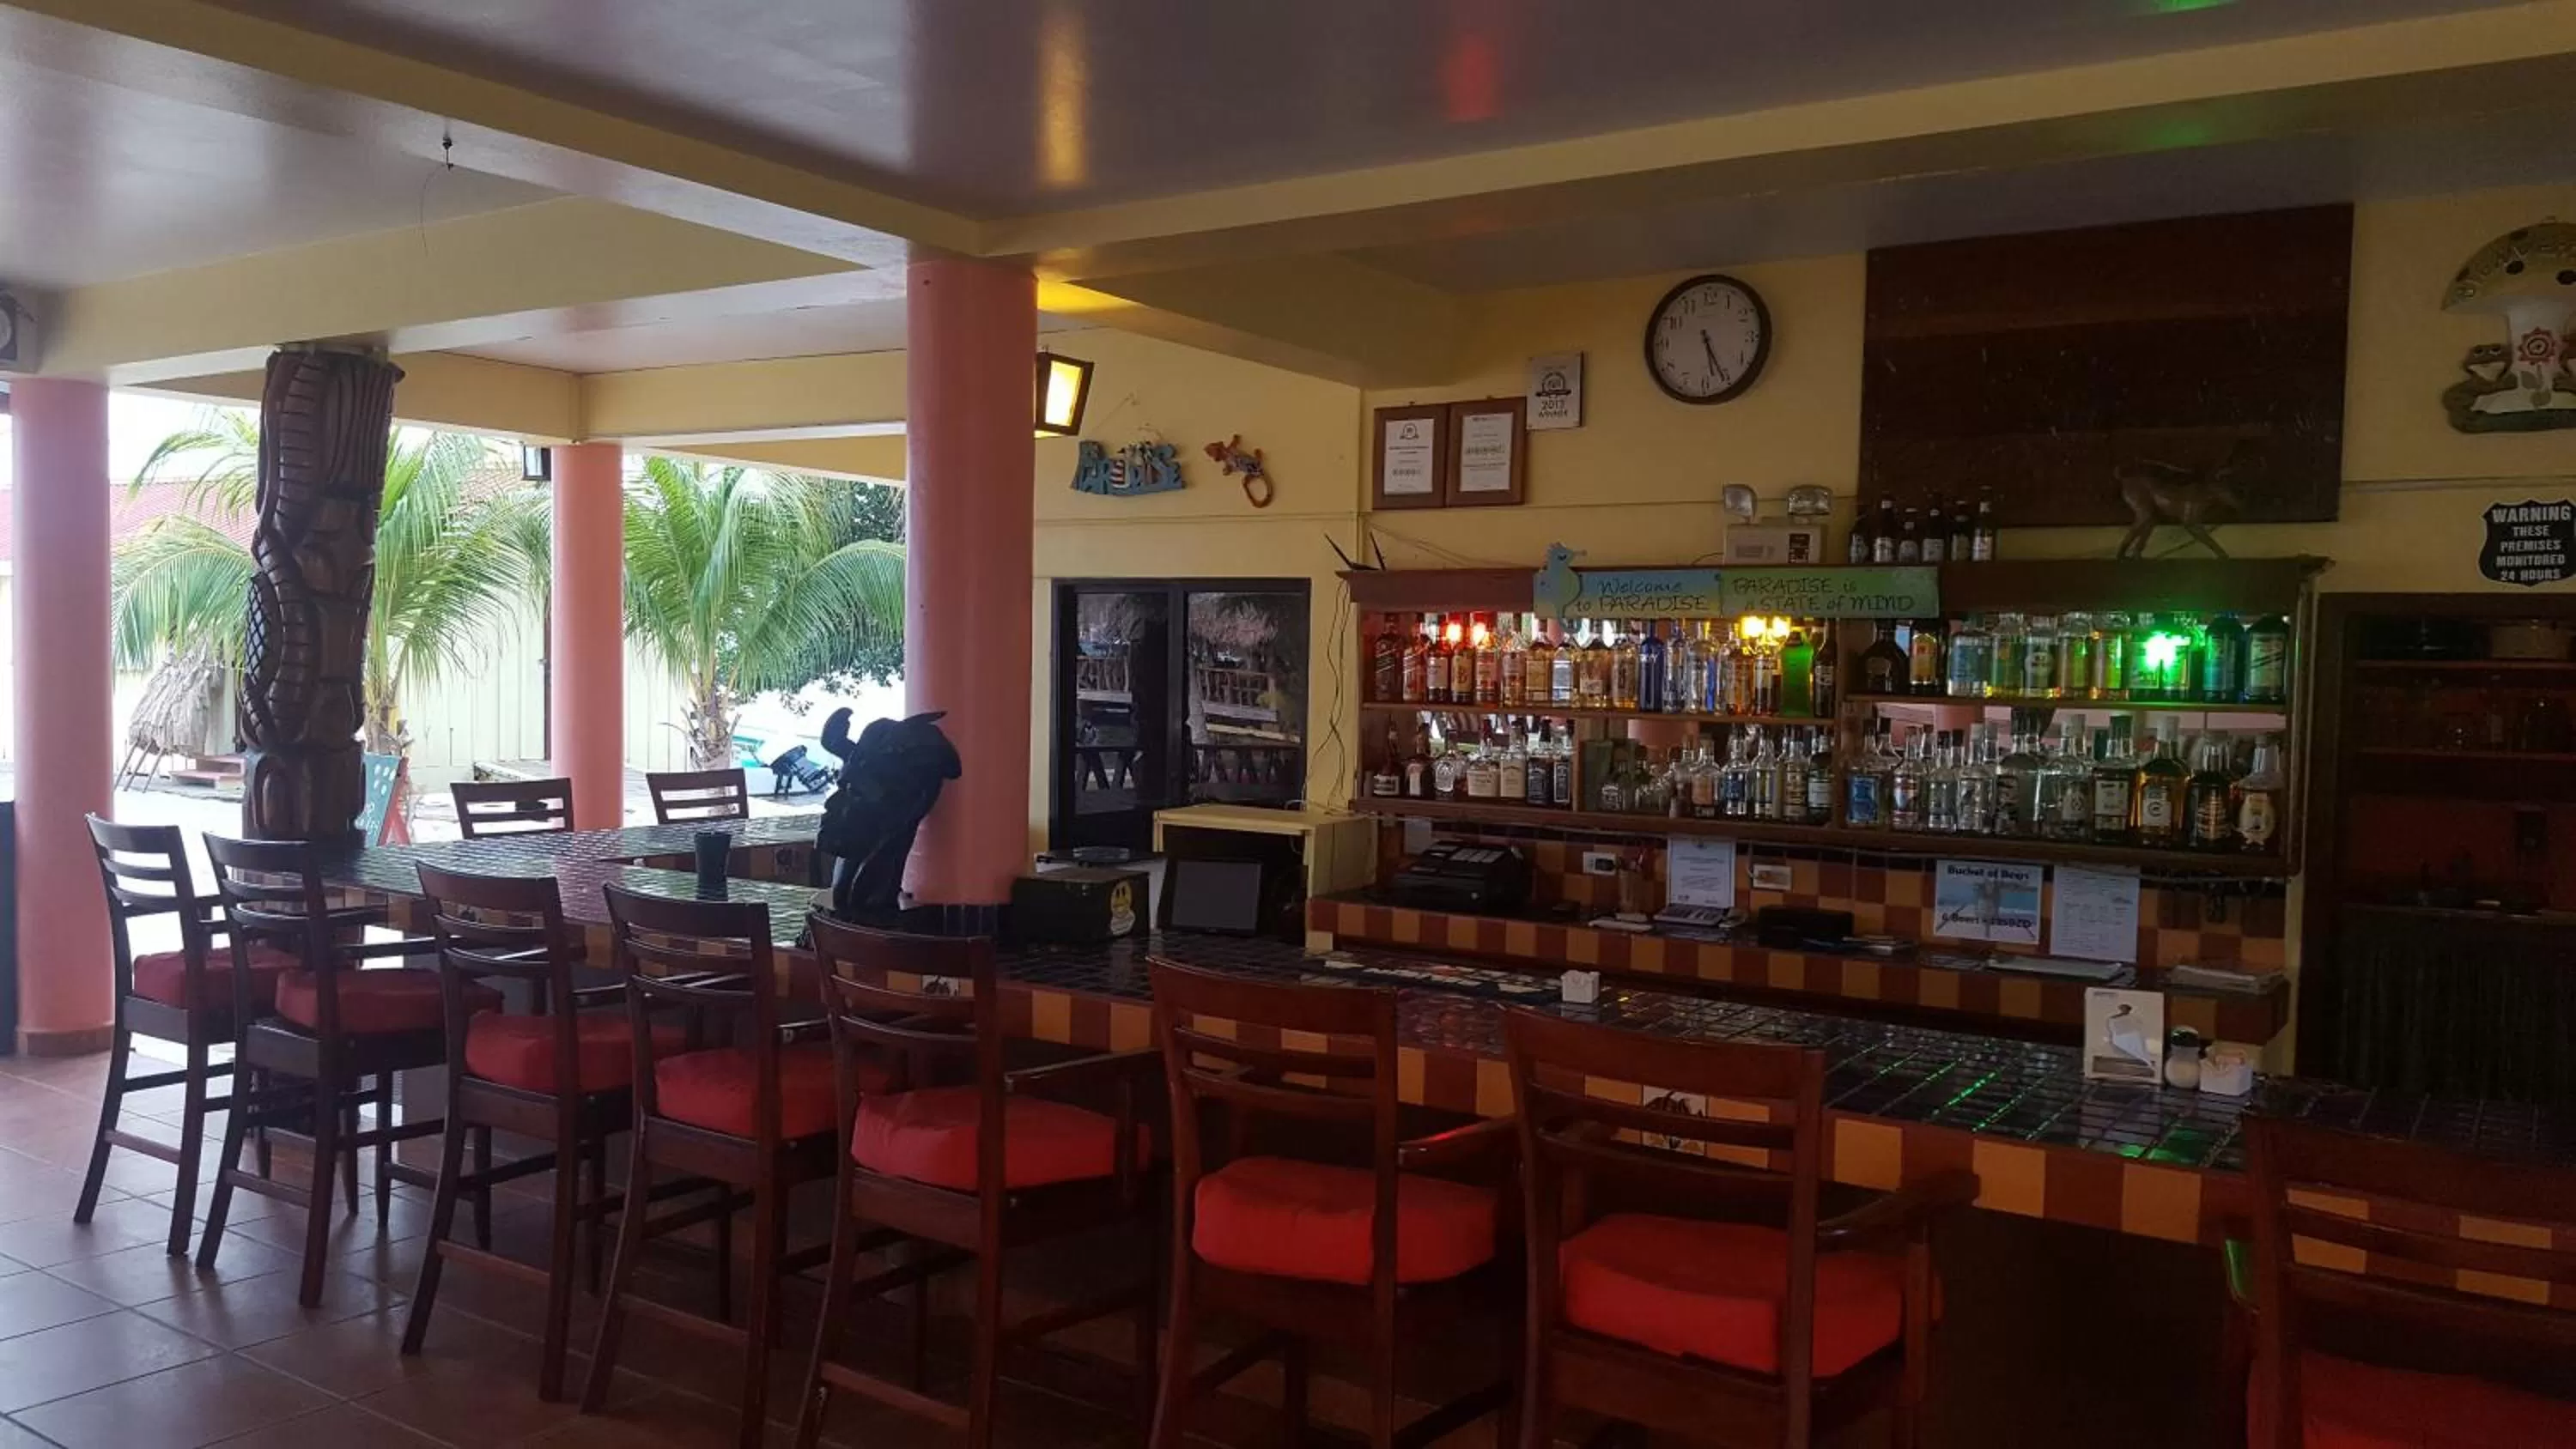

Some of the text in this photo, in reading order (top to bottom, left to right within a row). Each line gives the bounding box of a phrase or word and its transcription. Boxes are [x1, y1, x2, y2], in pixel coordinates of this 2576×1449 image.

[2492, 505, 2572, 523] WARNING
[2512, 524, 2550, 537] THESE
[2500, 539, 2561, 554] PREMISES
[2495, 553, 2566, 567] MONITORED
[2500, 568, 2561, 581] 24 HOURS
[1597, 579, 1683, 595] Welcome
[1731, 577, 1835, 594] PARADISE
[1575, 594, 1711, 612] to PARADISE
[1759, 594, 1822, 612] STATE
[1826, 594, 1846, 611] of
[1849, 594, 1916, 612] MIND
[1947, 864, 1984, 876] Bucket
[1987, 869, 1999, 879] of
